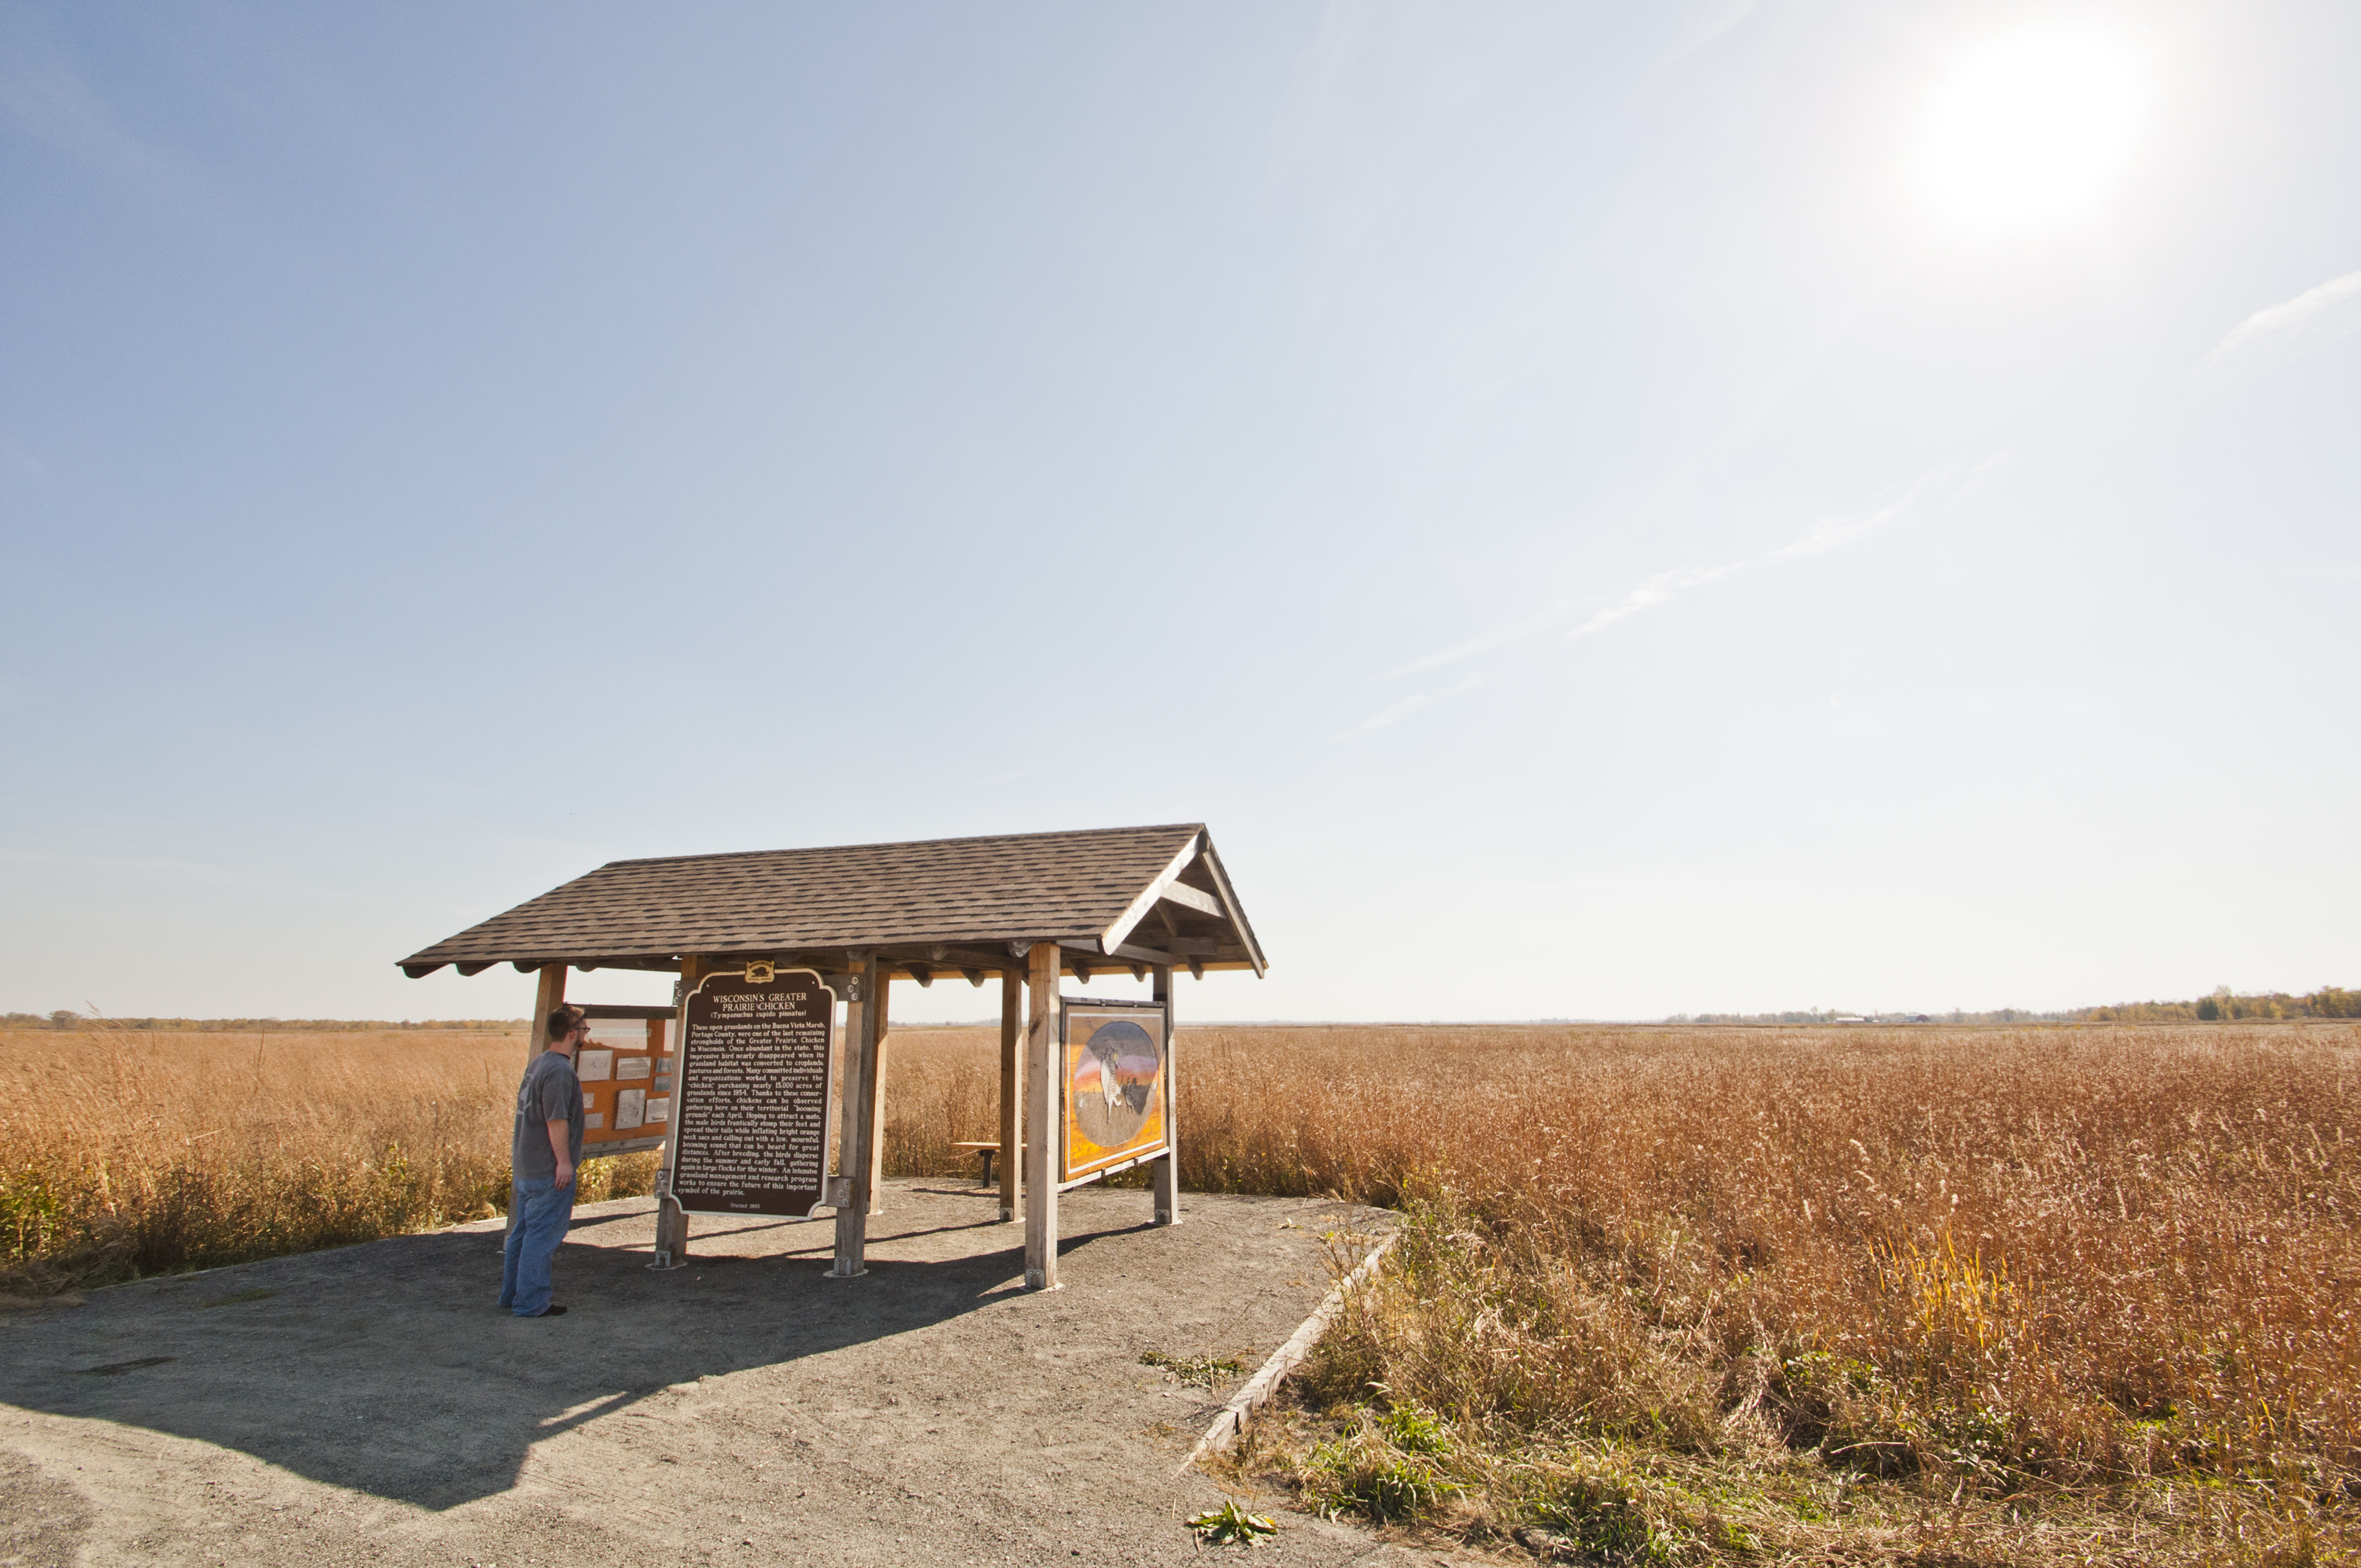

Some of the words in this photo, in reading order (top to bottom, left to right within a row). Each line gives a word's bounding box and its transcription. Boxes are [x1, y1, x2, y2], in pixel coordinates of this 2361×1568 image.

[713, 993, 764, 1003] WISCONSIN'S
[769, 993, 807, 1001] GREATER
[723, 1003, 755, 1011] PRAIRIE
[759, 1003, 795, 1011] CHICKEN
[709, 1173, 746, 1181] management
[786, 1183, 817, 1191] important
